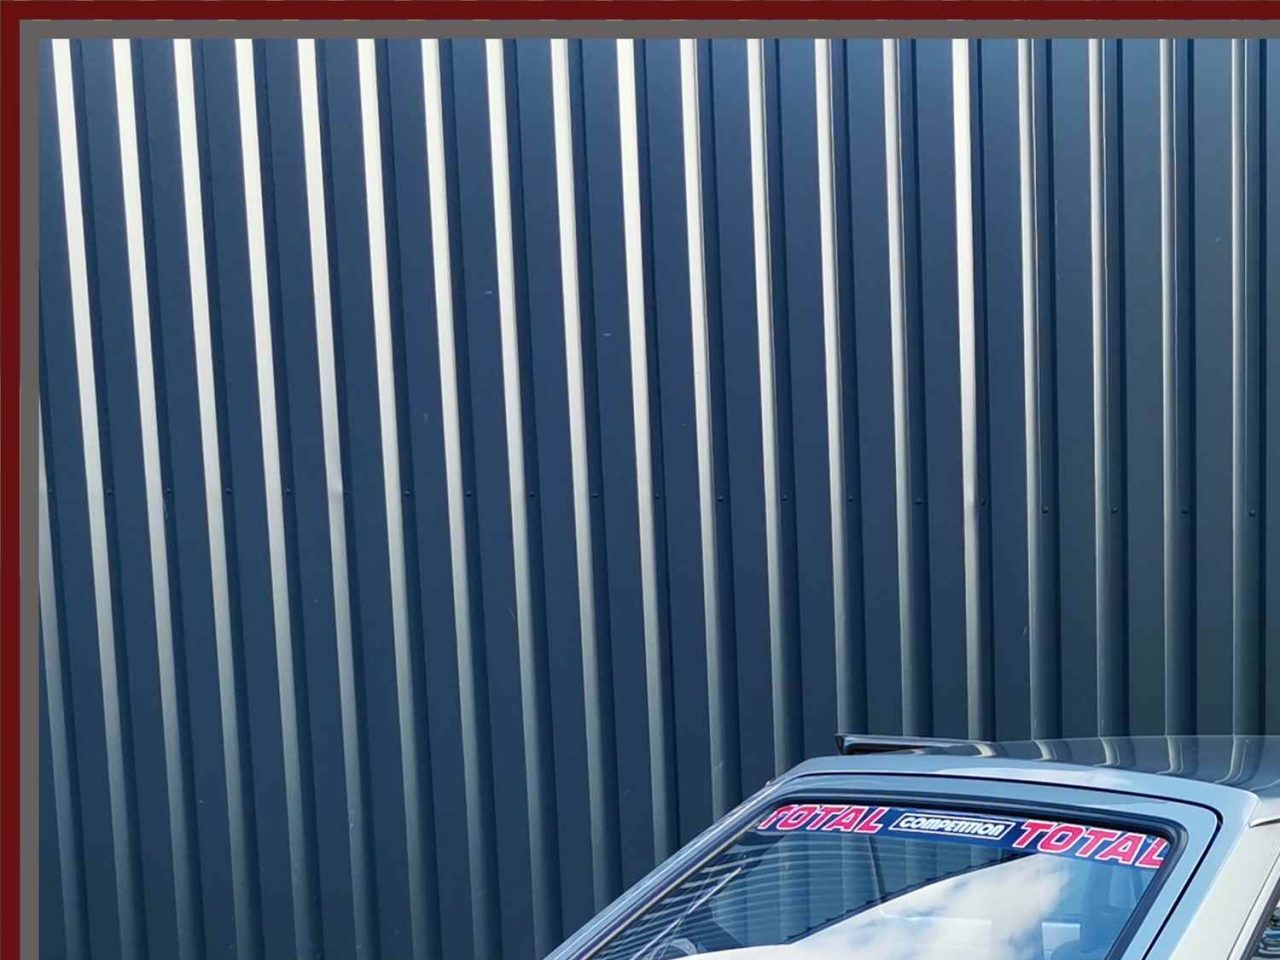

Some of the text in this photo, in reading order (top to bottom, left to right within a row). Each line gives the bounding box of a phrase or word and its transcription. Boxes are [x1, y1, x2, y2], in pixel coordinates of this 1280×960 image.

[757, 804, 1169, 868] TOTAL COMPETITION TOTAL
